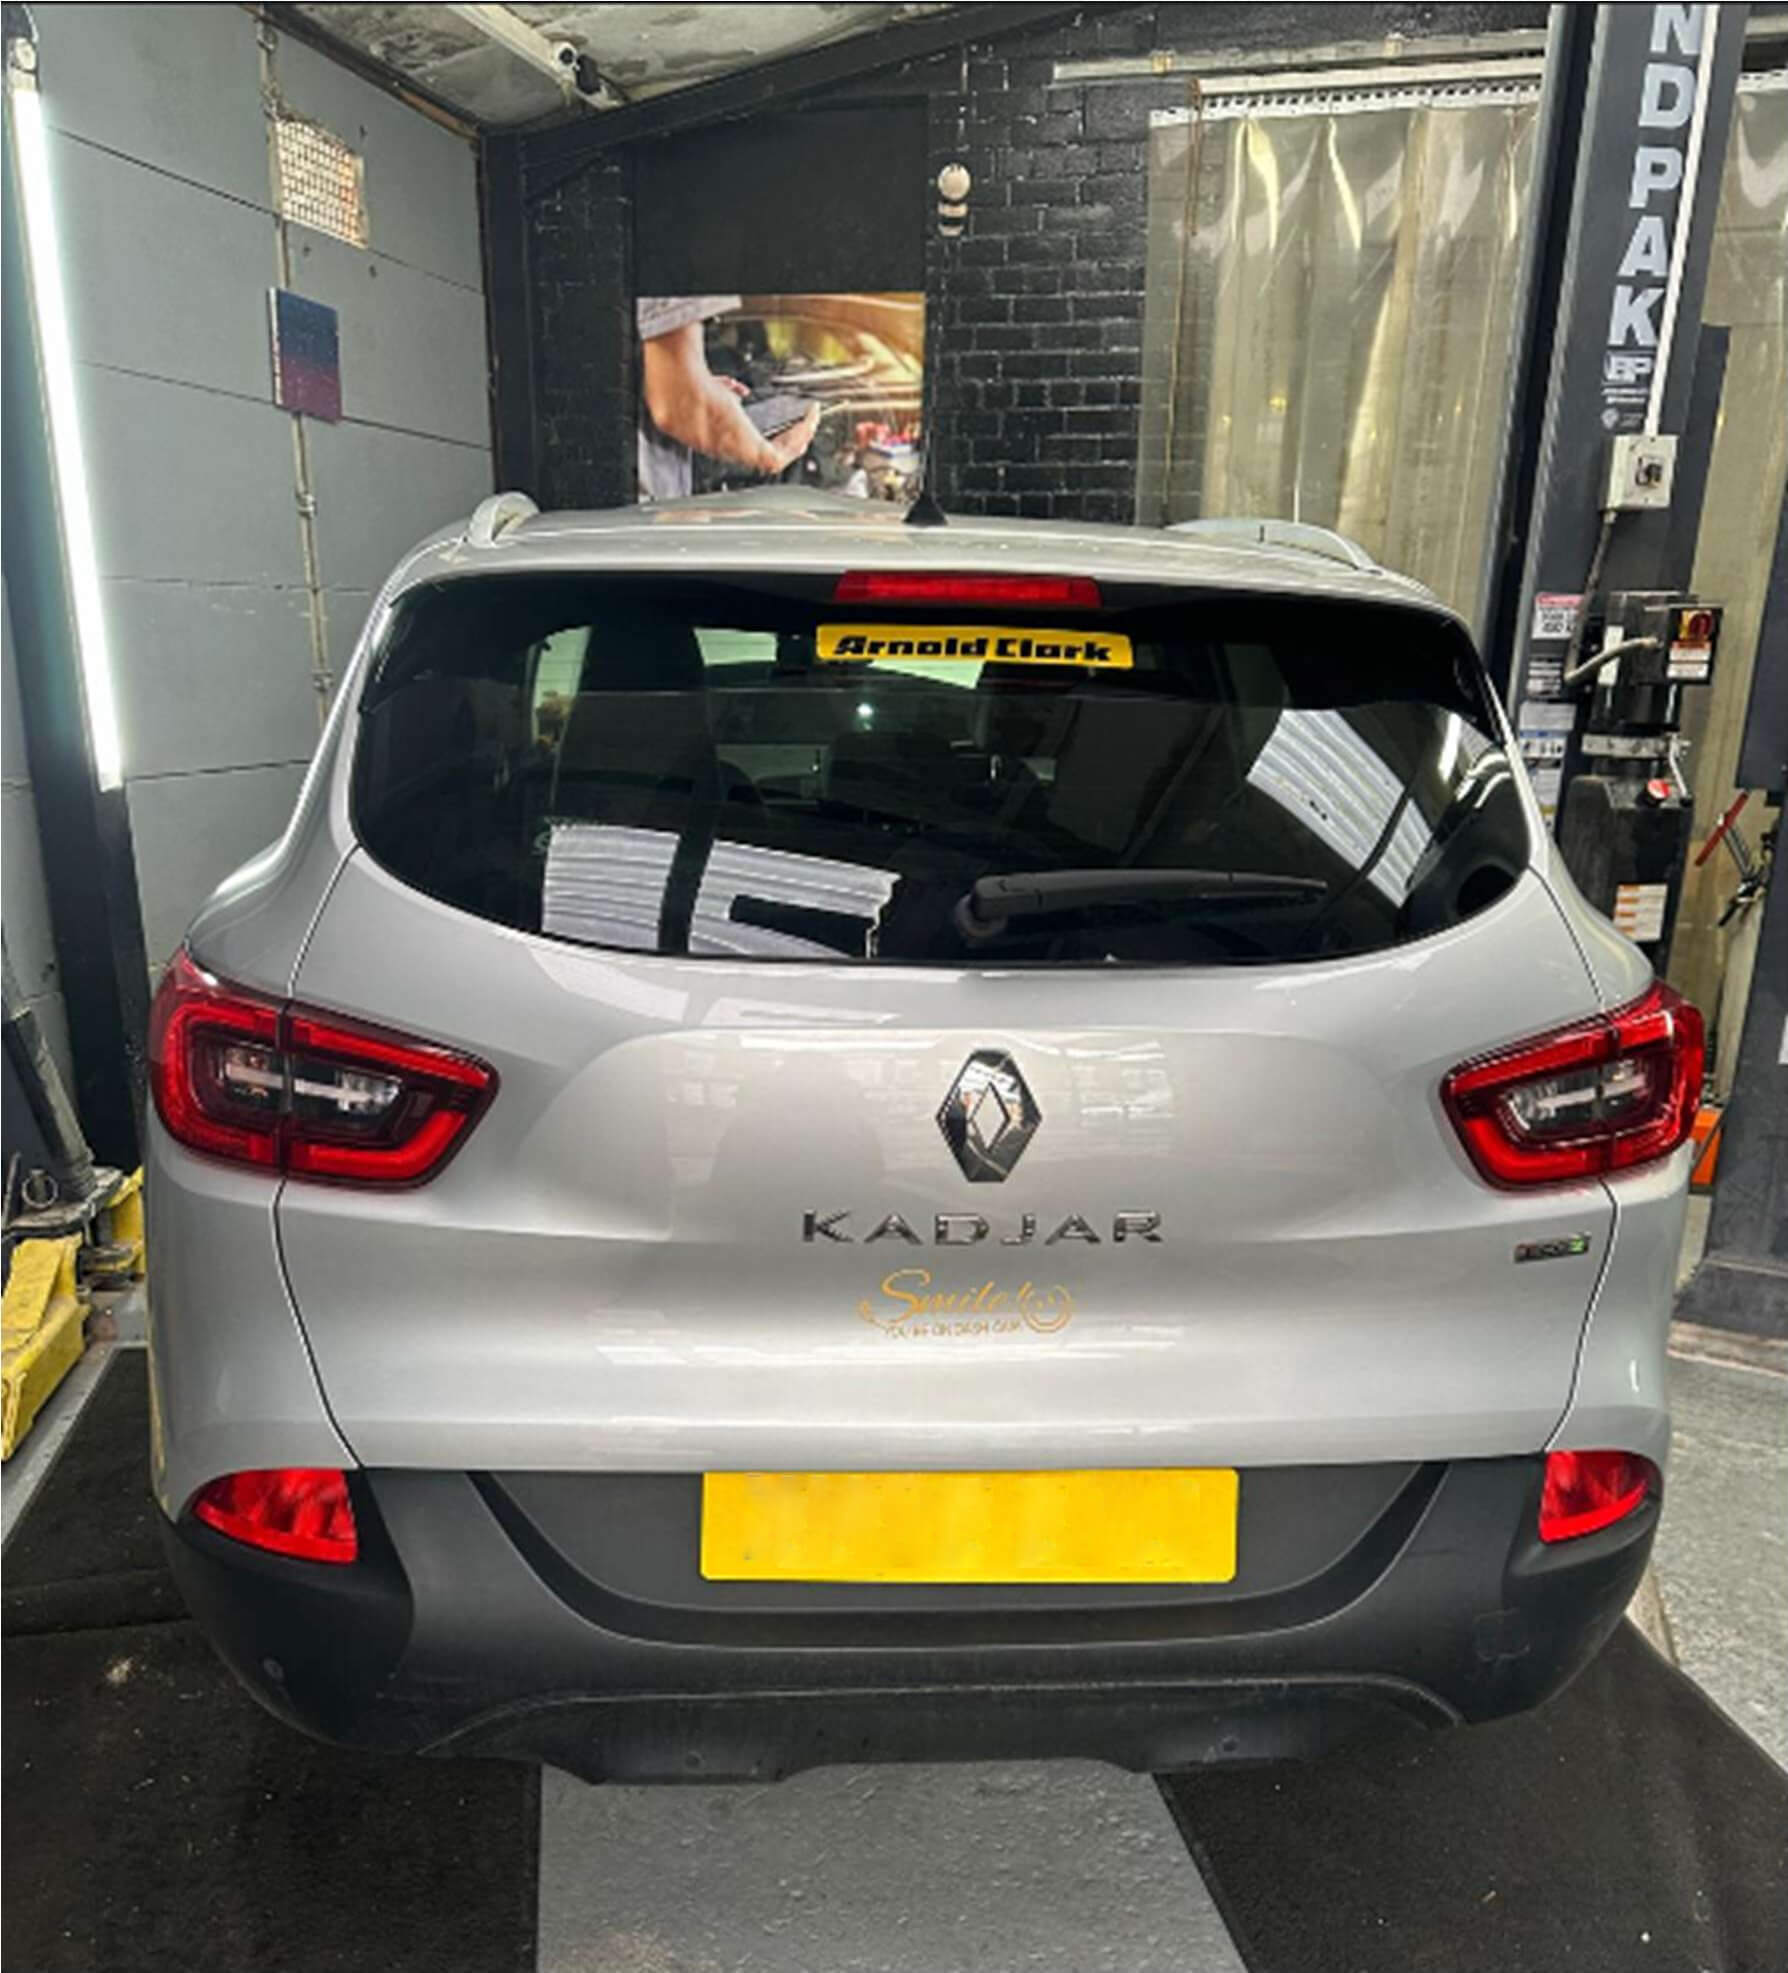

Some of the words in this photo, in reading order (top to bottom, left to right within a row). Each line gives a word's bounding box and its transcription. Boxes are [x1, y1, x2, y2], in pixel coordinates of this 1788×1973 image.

[834, 634, 988, 658] Arnold
[995, 637, 1112, 662] Clark
[801, 1209, 1163, 1245] KADJAR
